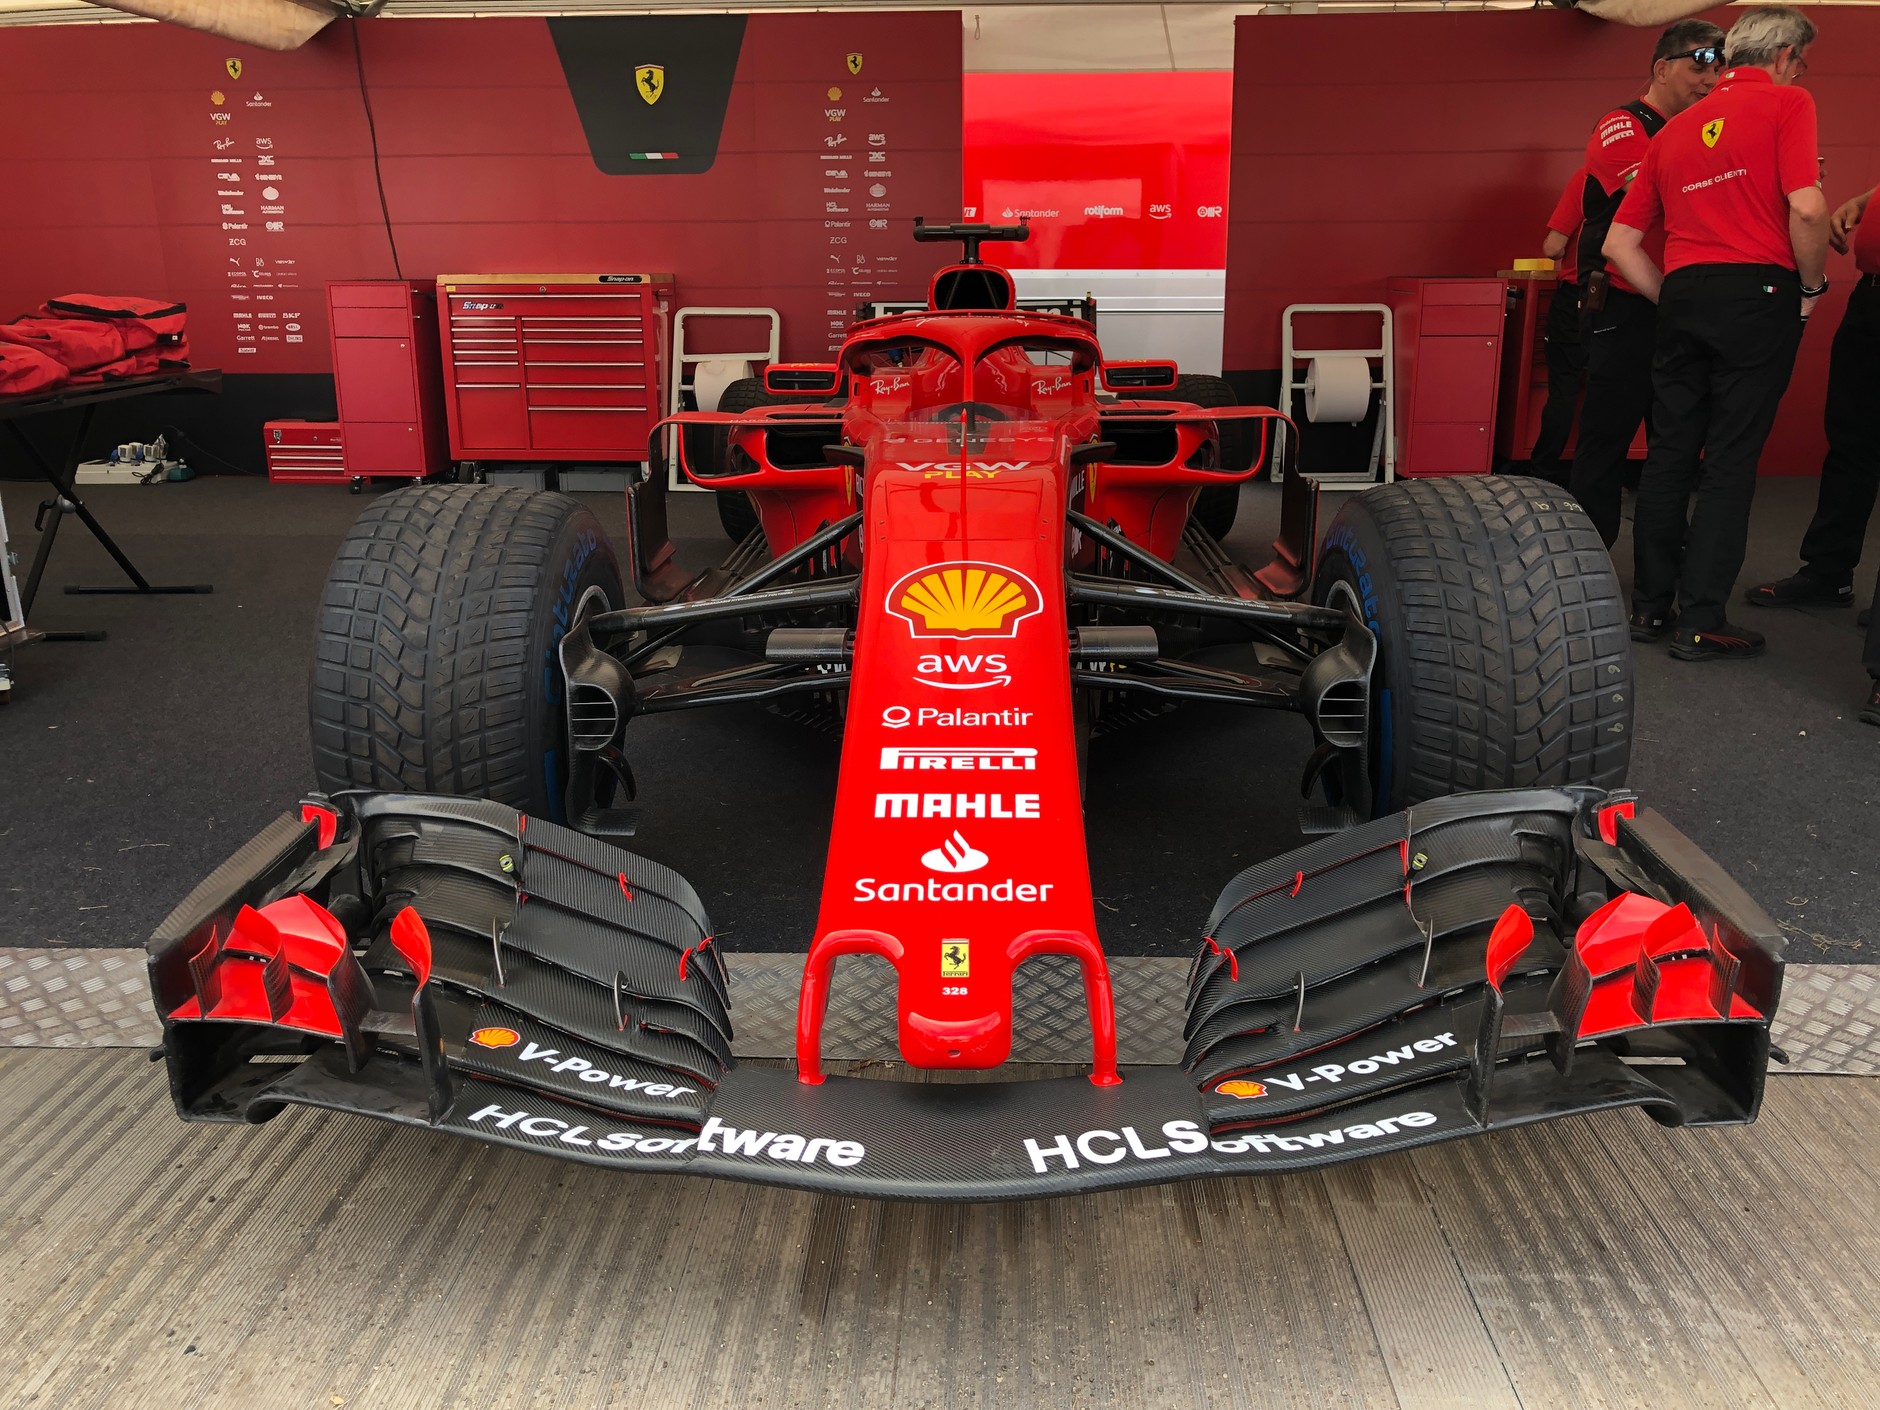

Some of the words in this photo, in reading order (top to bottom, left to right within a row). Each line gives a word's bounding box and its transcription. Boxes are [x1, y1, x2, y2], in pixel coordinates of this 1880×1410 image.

[824, 109, 846, 117] VGW
[1601, 121, 1632, 139] MAHLE
[1682, 178, 1713, 193] CORSE
[1714, 168, 1747, 183] CLIENTI
[1014, 209, 1059, 217] Santander
[1084, 205, 1123, 218] rotiform
[1149, 204, 1171, 213] aws
[870, 376, 910, 395] Ray-Ban
[1032, 376, 1072, 395] Ray-Ban
[896, 461, 1031, 471] VGW
[924, 470, 1002, 479] PLAY
[917, 654, 1007, 673] aws
[918, 708, 1033, 726] Palantir
[880, 747, 1038, 770] PIRELLI
[874, 793, 1041, 818] MAHLE
[854, 878, 1054, 902] Santander
[942, 986, 968, 996] 328
[518, 1041, 697, 1099] V-Power
[1263, 1032, 1458, 1091] V-Power
